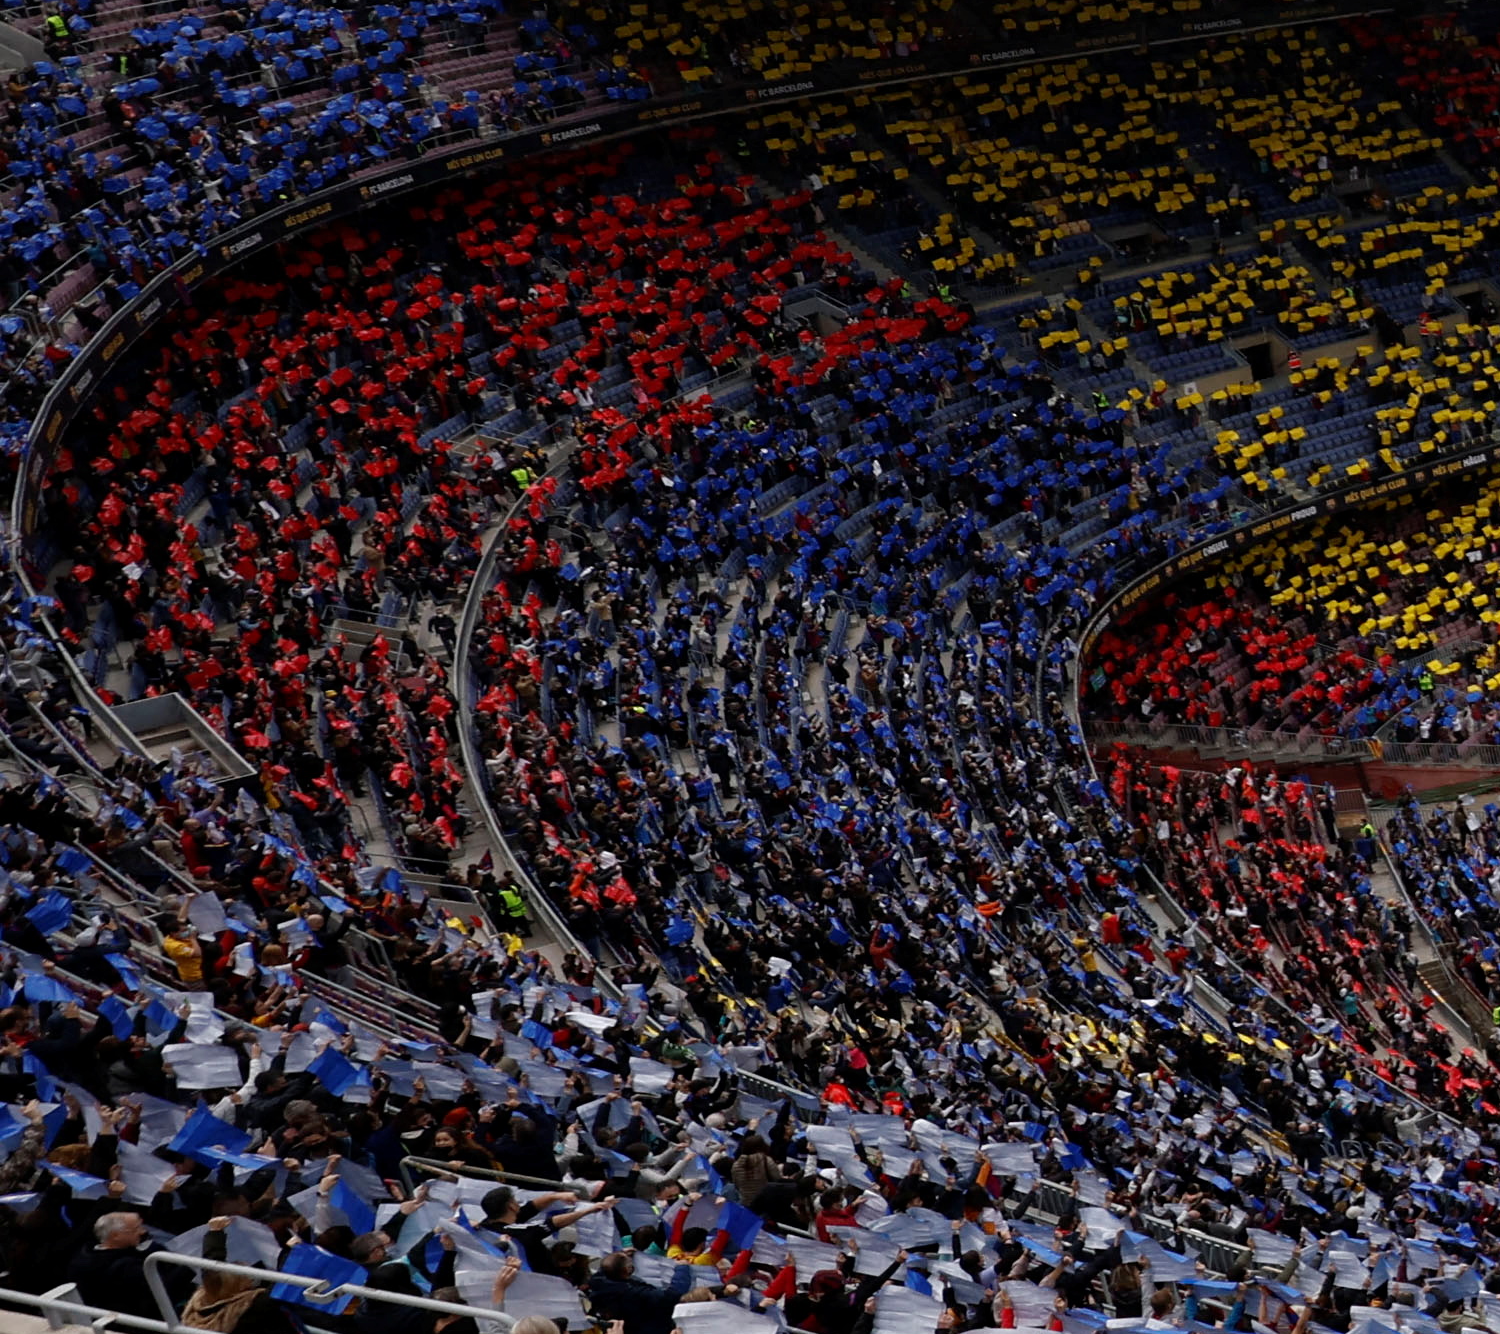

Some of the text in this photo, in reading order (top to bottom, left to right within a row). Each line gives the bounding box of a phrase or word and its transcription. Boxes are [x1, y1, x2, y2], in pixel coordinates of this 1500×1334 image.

[769, 80, 814, 96] BARCELONA
[1361, 487, 1375, 500] QUE
[1376, 484, 1386, 496] UN
[1386, 478, 1407, 493] CLUB
